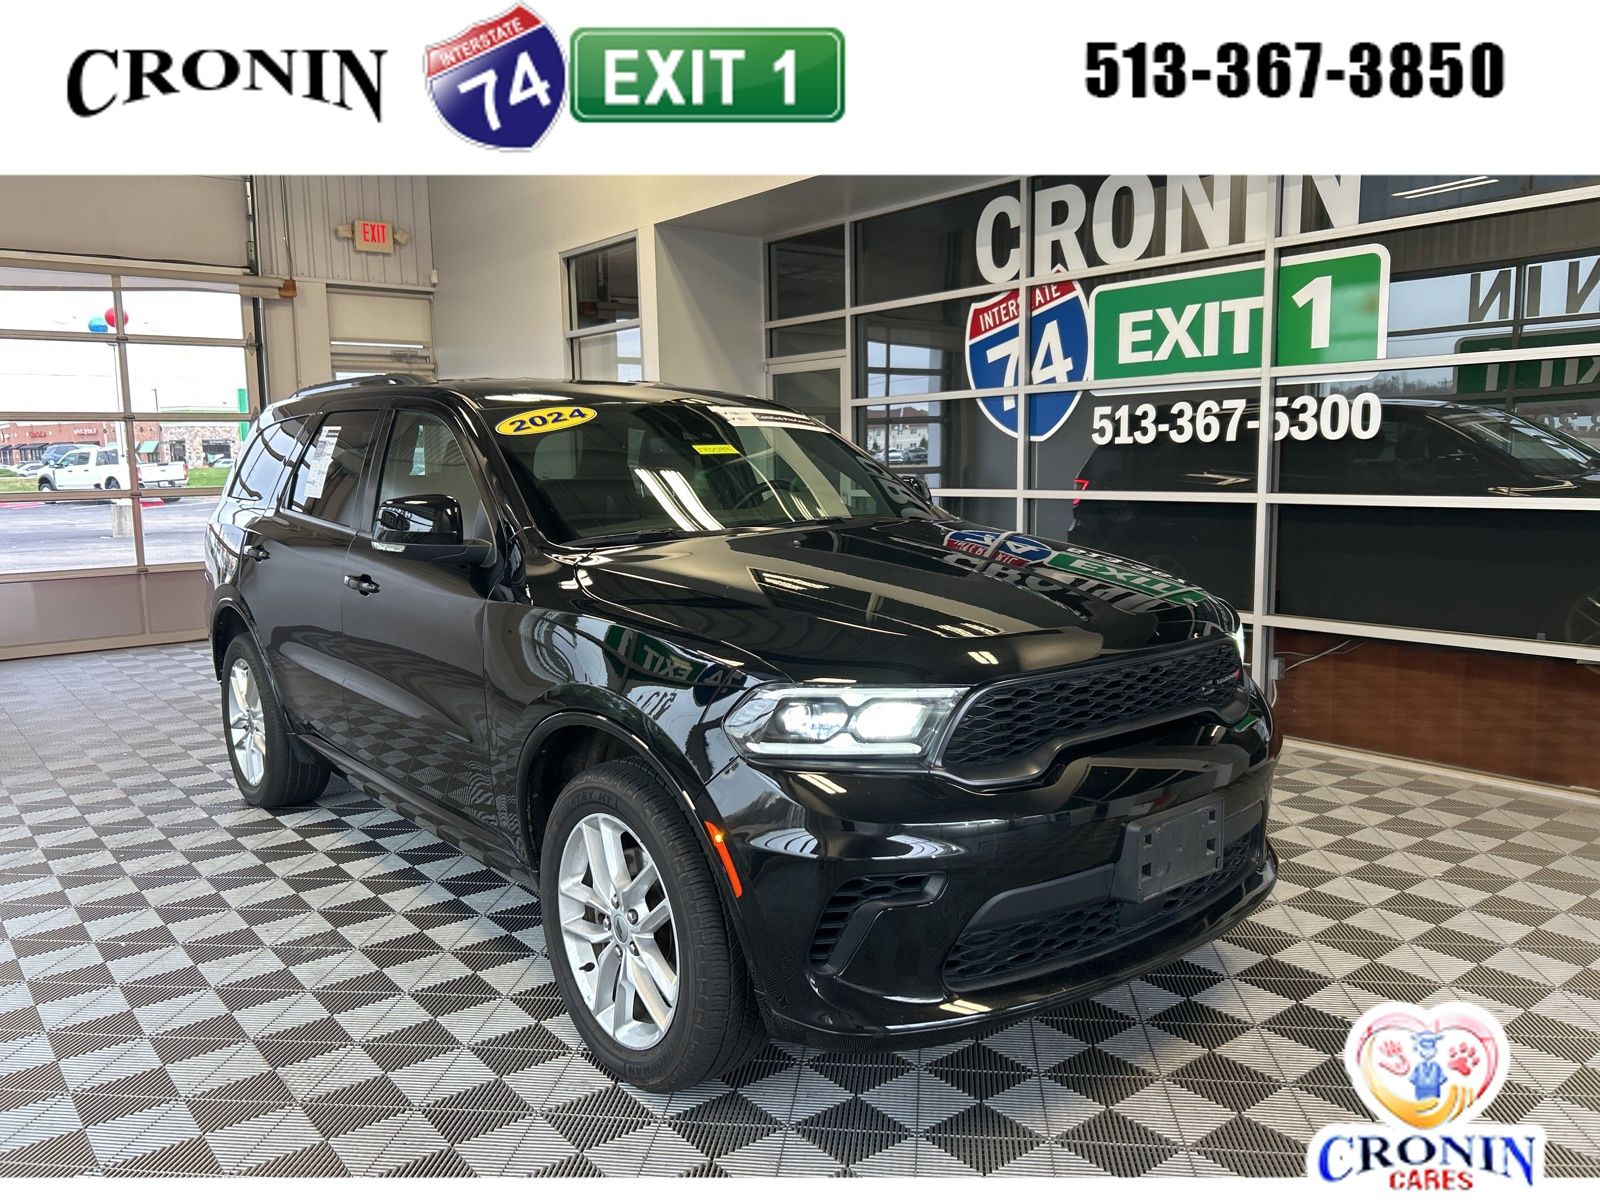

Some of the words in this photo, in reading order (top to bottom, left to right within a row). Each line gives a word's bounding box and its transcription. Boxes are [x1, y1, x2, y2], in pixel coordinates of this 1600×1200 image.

[362, 223, 387, 243] EXIT
[976, 175, 1360, 284] CRONIN
[1117, 295, 1265, 365] EXIT
[1292, 275, 1333, 350] 1
[986, 319, 1074, 412] 74
[508, 408, 587, 432] 2024
[1091, 392, 1382, 446] 513-367-5300
